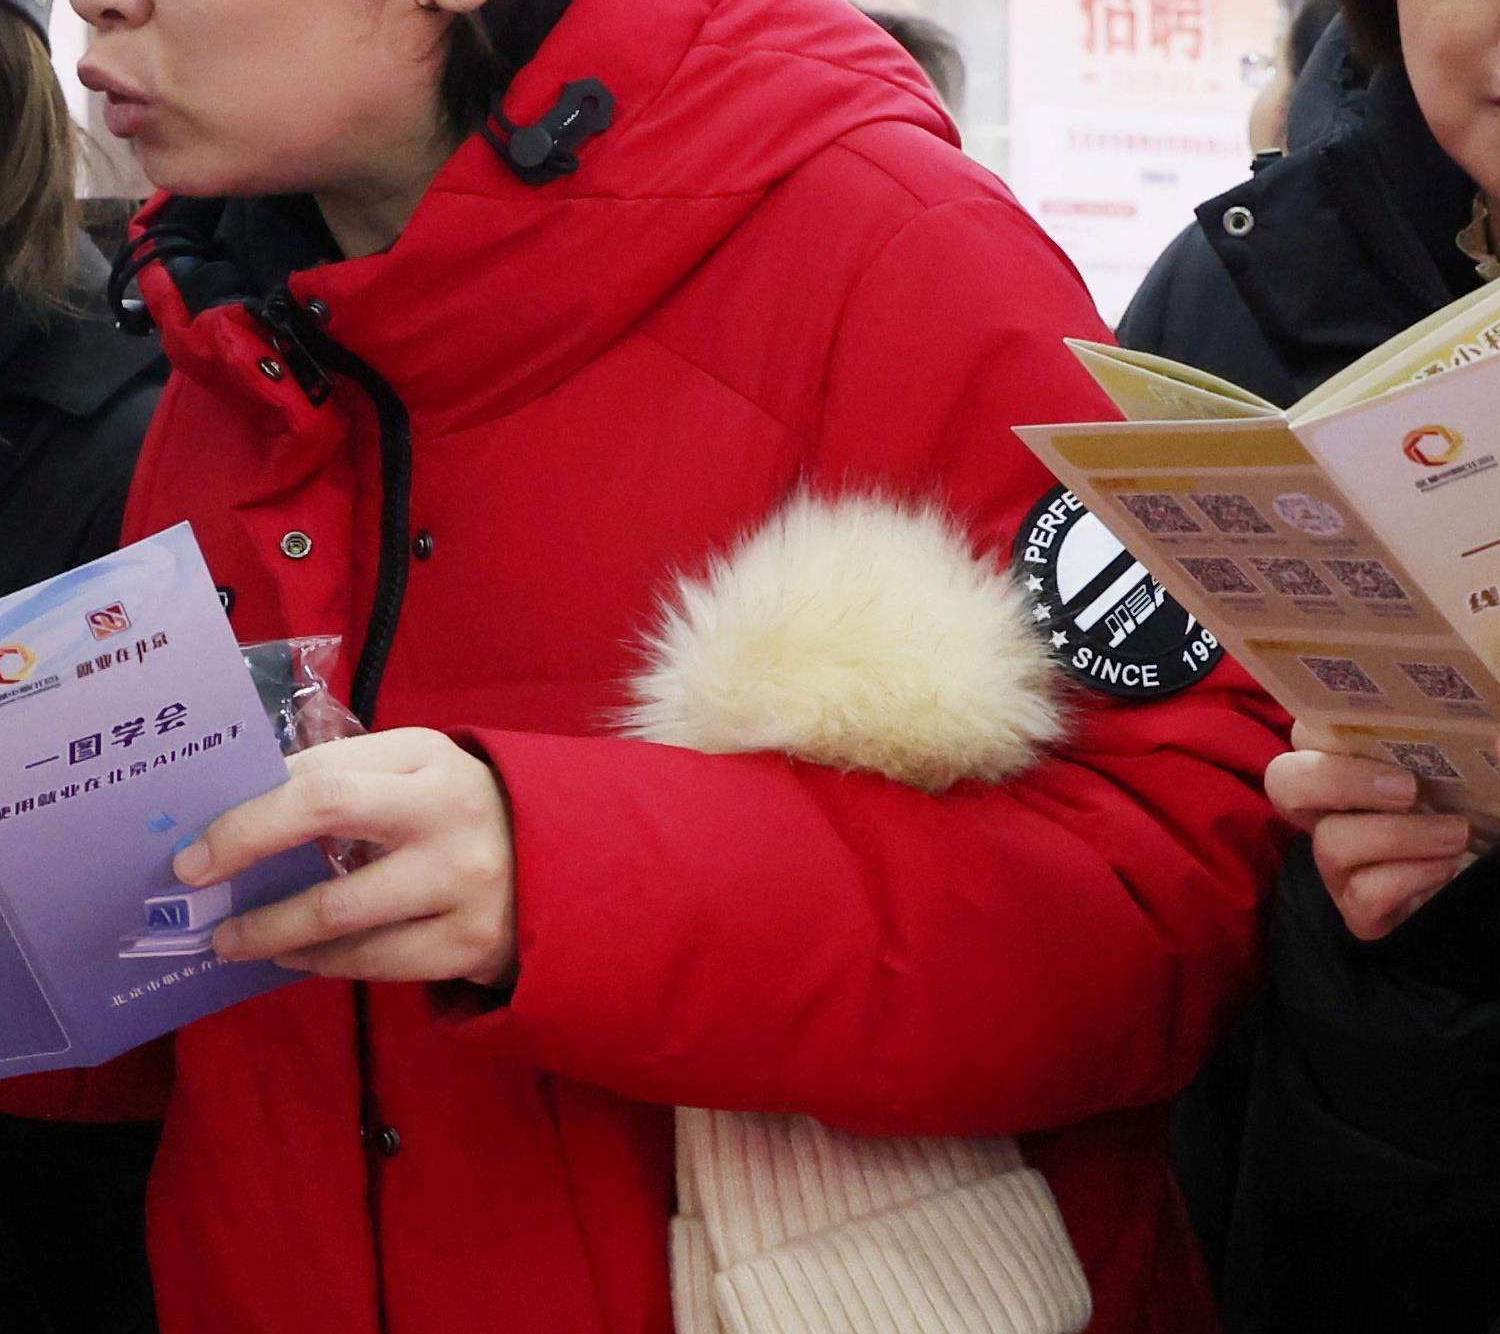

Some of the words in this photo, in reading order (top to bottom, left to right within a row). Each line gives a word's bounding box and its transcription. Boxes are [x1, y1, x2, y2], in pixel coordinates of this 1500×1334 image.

[1024, 489, 1085, 564] PERFE
[76, 631, 169, 679] 就业在北京
[1072, 647, 1161, 688] SINCE
[25, 702, 188, 770] 一图学会
